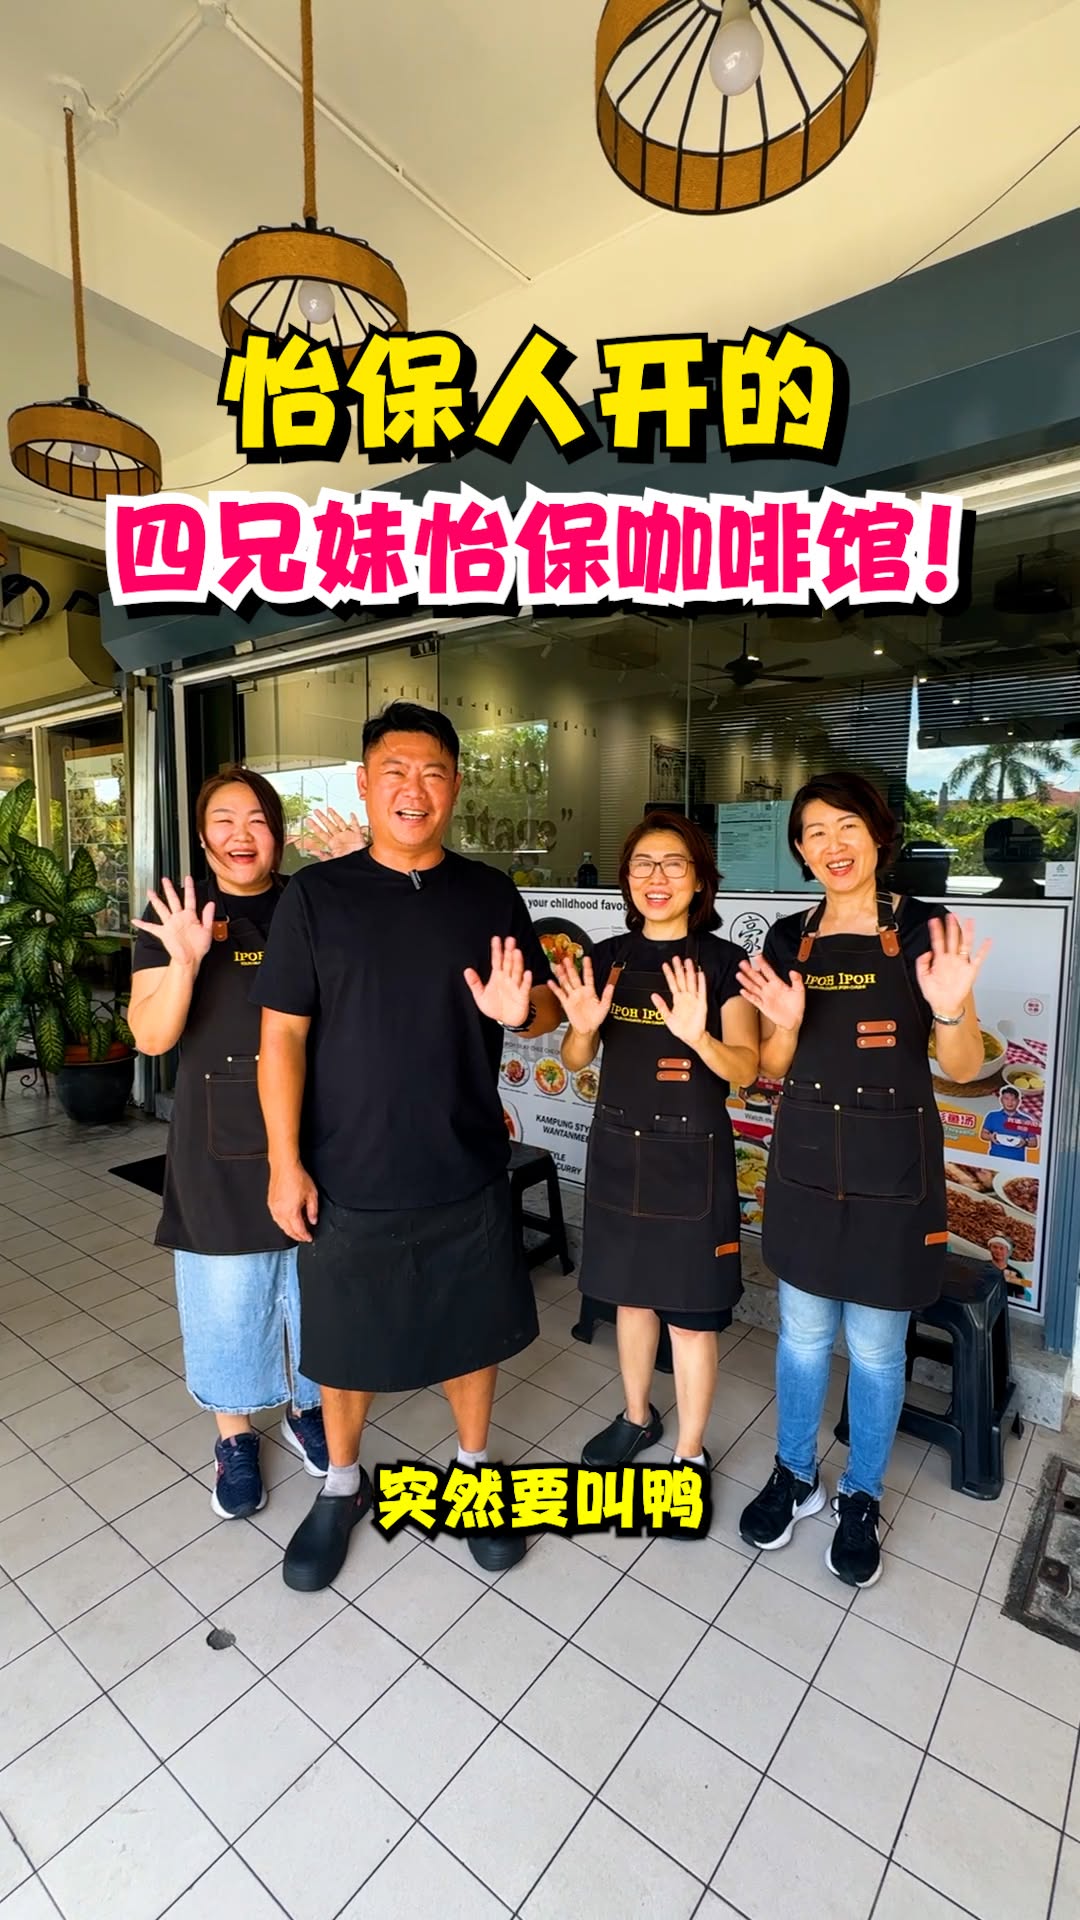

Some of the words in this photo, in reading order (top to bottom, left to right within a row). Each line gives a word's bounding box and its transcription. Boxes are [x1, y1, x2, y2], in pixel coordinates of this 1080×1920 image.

[528, 899, 548, 909] your
[550, 898, 598, 910] childhood
[804, 974, 835, 986] IPOH
[838, 972, 876, 985] IPOH
[610, 1002, 638, 1018] IPOH
[642, 1008, 665, 1021] IPO
[536, 1114, 574, 1130] KAMPUNG
[575, 1122, 590, 1133] STY
[556, 1162, 583, 1174] CURRY
